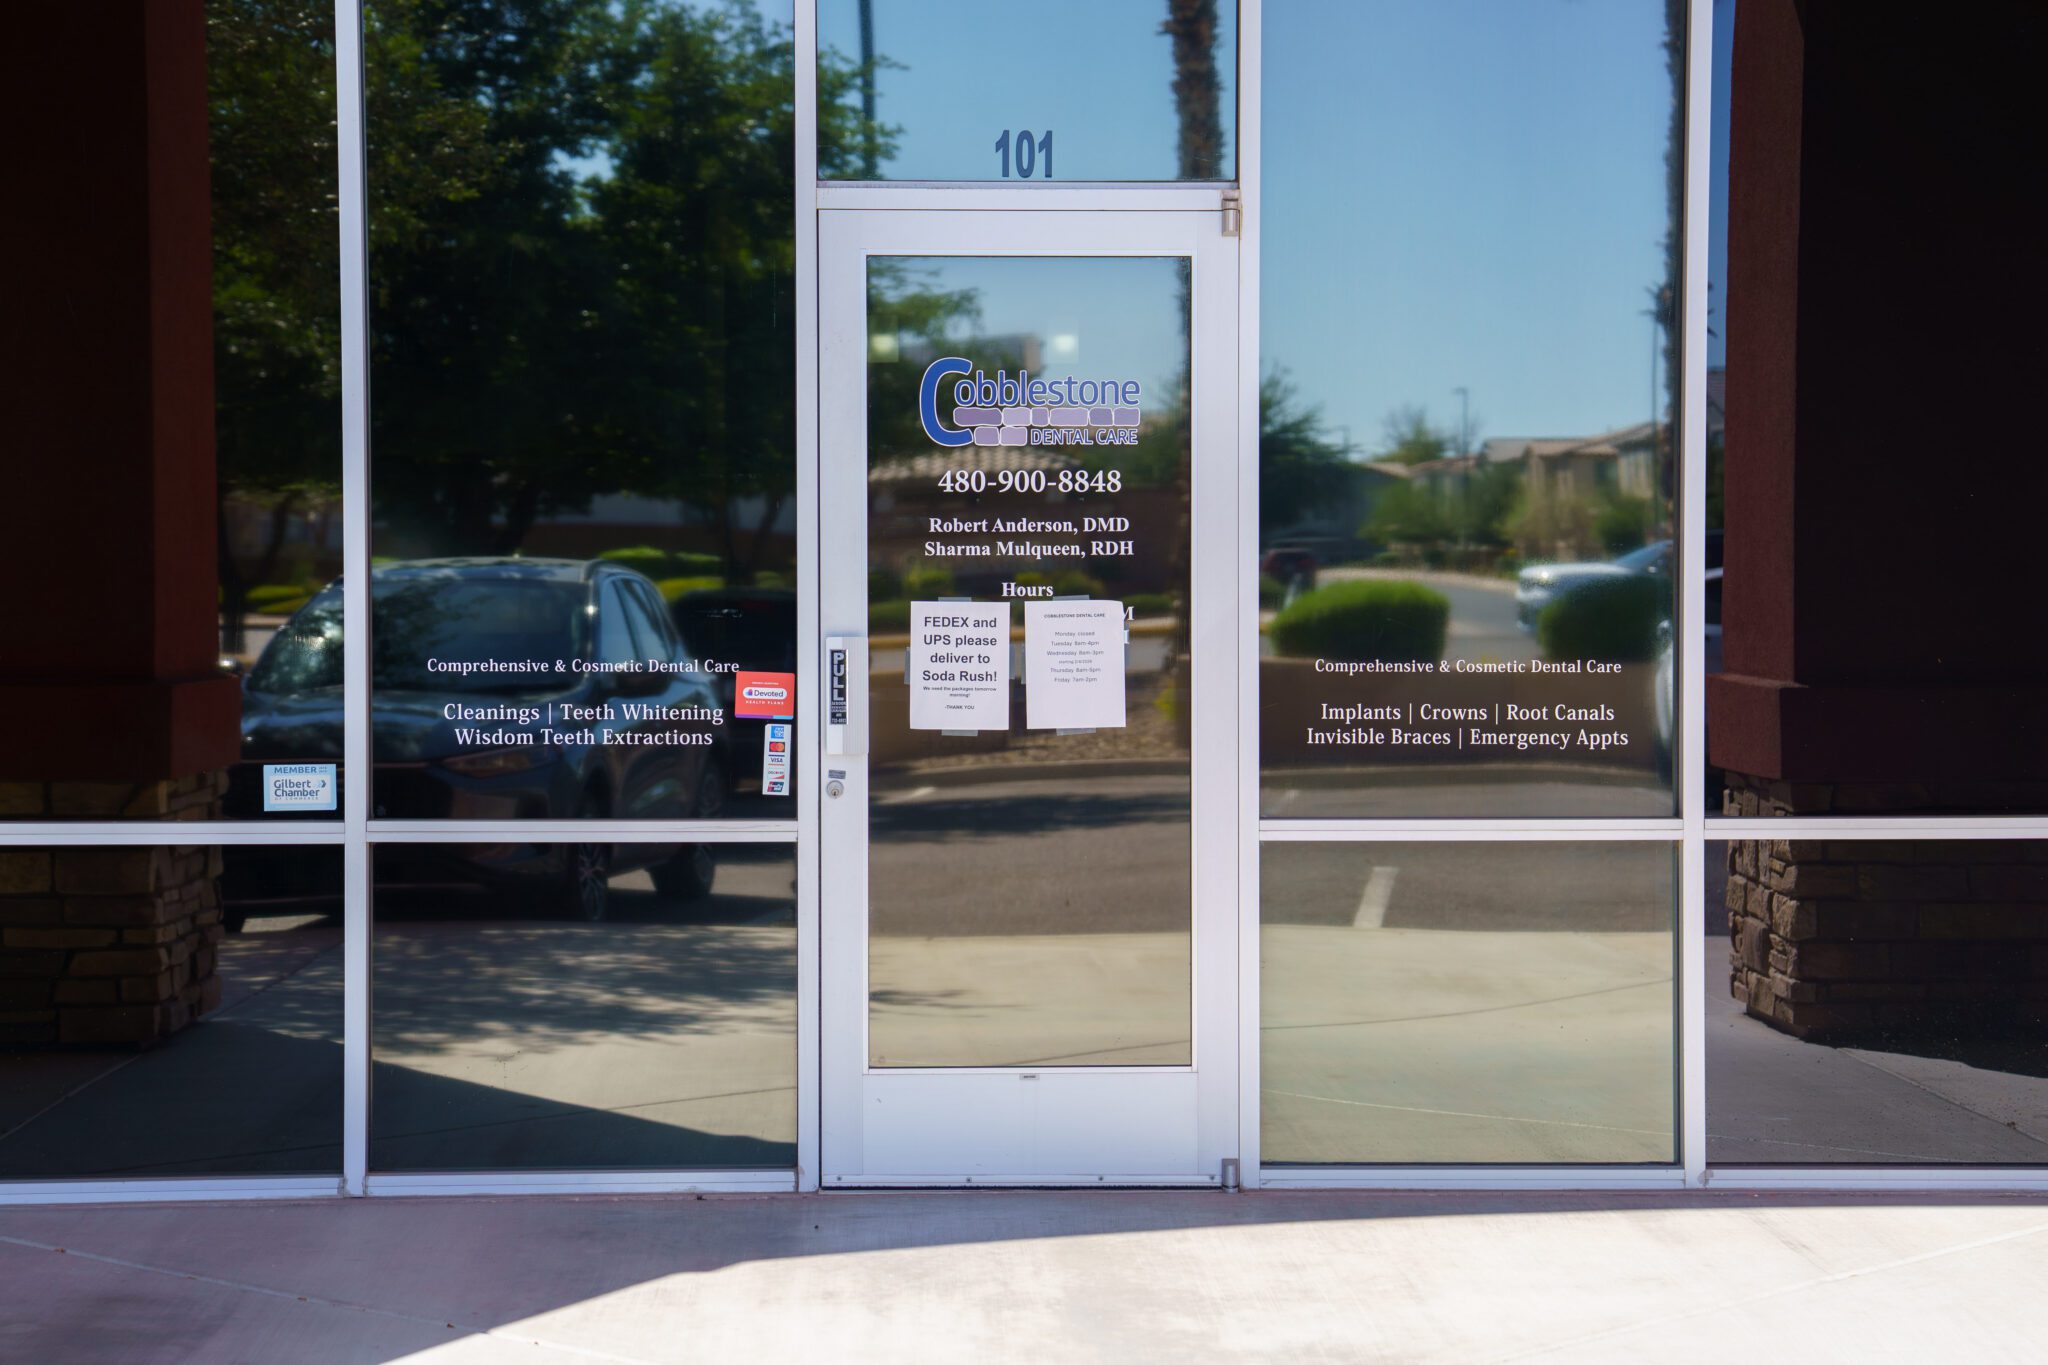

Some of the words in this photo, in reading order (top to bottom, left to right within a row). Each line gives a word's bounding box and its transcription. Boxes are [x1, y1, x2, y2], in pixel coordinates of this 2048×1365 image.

[995, 130, 1052, 178] 101
[919, 357, 1140, 447] Cobblestone
[1030, 428, 1093, 445] DENTAL
[1095, 428, 1138, 445] CARE
[938, 470, 1122, 493] 480-900-8848
[929, 517, 987, 533] Robert
[992, 517, 1078, 535] Anderson,
[1083, 517, 1130, 533] DMD
[925, 541, 990, 556] Sharma
[996, 541, 1086, 559] Mulqueen,
[1090, 541, 1134, 556] RDH
[1002, 582, 1054, 597] Hours
[924, 616, 969, 627] FEDEX
[973, 618, 997, 628] and
[924, 635, 951, 645] UPS
[956, 635, 997, 647] please
[427, 658, 549, 675] Comprehensive
[554, 660, 566, 672] &
[572, 659, 643, 673] Cosmetic
[648, 659, 699, 673] Dental
[704, 659, 740, 673] Care
[930, 653, 974, 663] deliver
[978, 654, 990, 664] to
[923, 670, 955, 681] Soda
[960, 671, 997, 681] Rush!
[1315, 659, 1434, 676] Comprehensive
[1439, 660, 1451, 673] &
[1456, 659, 1526, 673] Cosmetic
[1531, 659, 1581, 673] Dental
[1587, 660, 1622, 673] Care
[833, 652, 844, 701] PULL
[444, 703, 540, 725] Cleanings
[560, 703, 616, 720] Teeth
[621, 703, 724, 725] Whitening
[1321, 703, 1401, 724] Implants
[1420, 704, 1487, 721] Crowns
[1506, 704, 1548, 721] Root
[1555, 704, 1615, 721] Canals
[454, 728, 534, 745] Wisdom
[540, 728, 595, 745] Teeth
[602, 728, 713, 745] Extractions
[1307, 728, 1384, 745] Invisible
[1391, 728, 1451, 745] Braces
[1470, 729, 1570, 750] Emergency
[1577, 729, 1629, 750] Appts
[274, 779, 311, 788] Gilbert
[274, 788, 320, 796] Chamber
